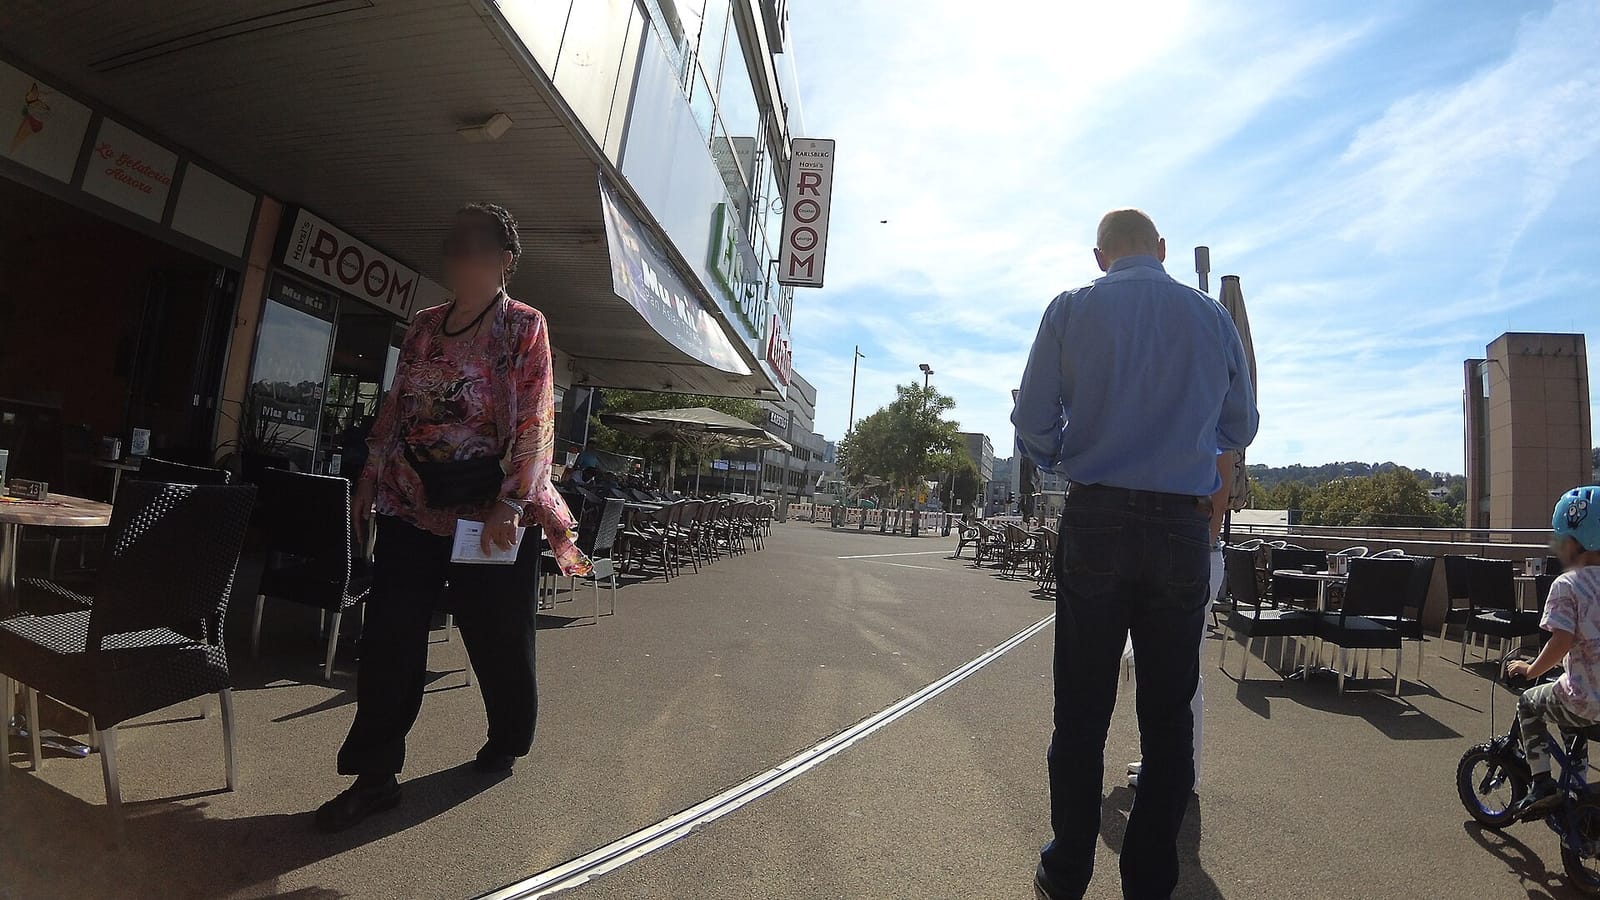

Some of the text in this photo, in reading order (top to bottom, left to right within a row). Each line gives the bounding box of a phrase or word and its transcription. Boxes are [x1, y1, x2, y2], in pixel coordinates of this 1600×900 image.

[116, 152, 171, 185] Gelateria
[795, 150, 829, 158] KARLSBERG
[788, 172, 823, 278] ROOM
[308, 228, 414, 311] ROOM
